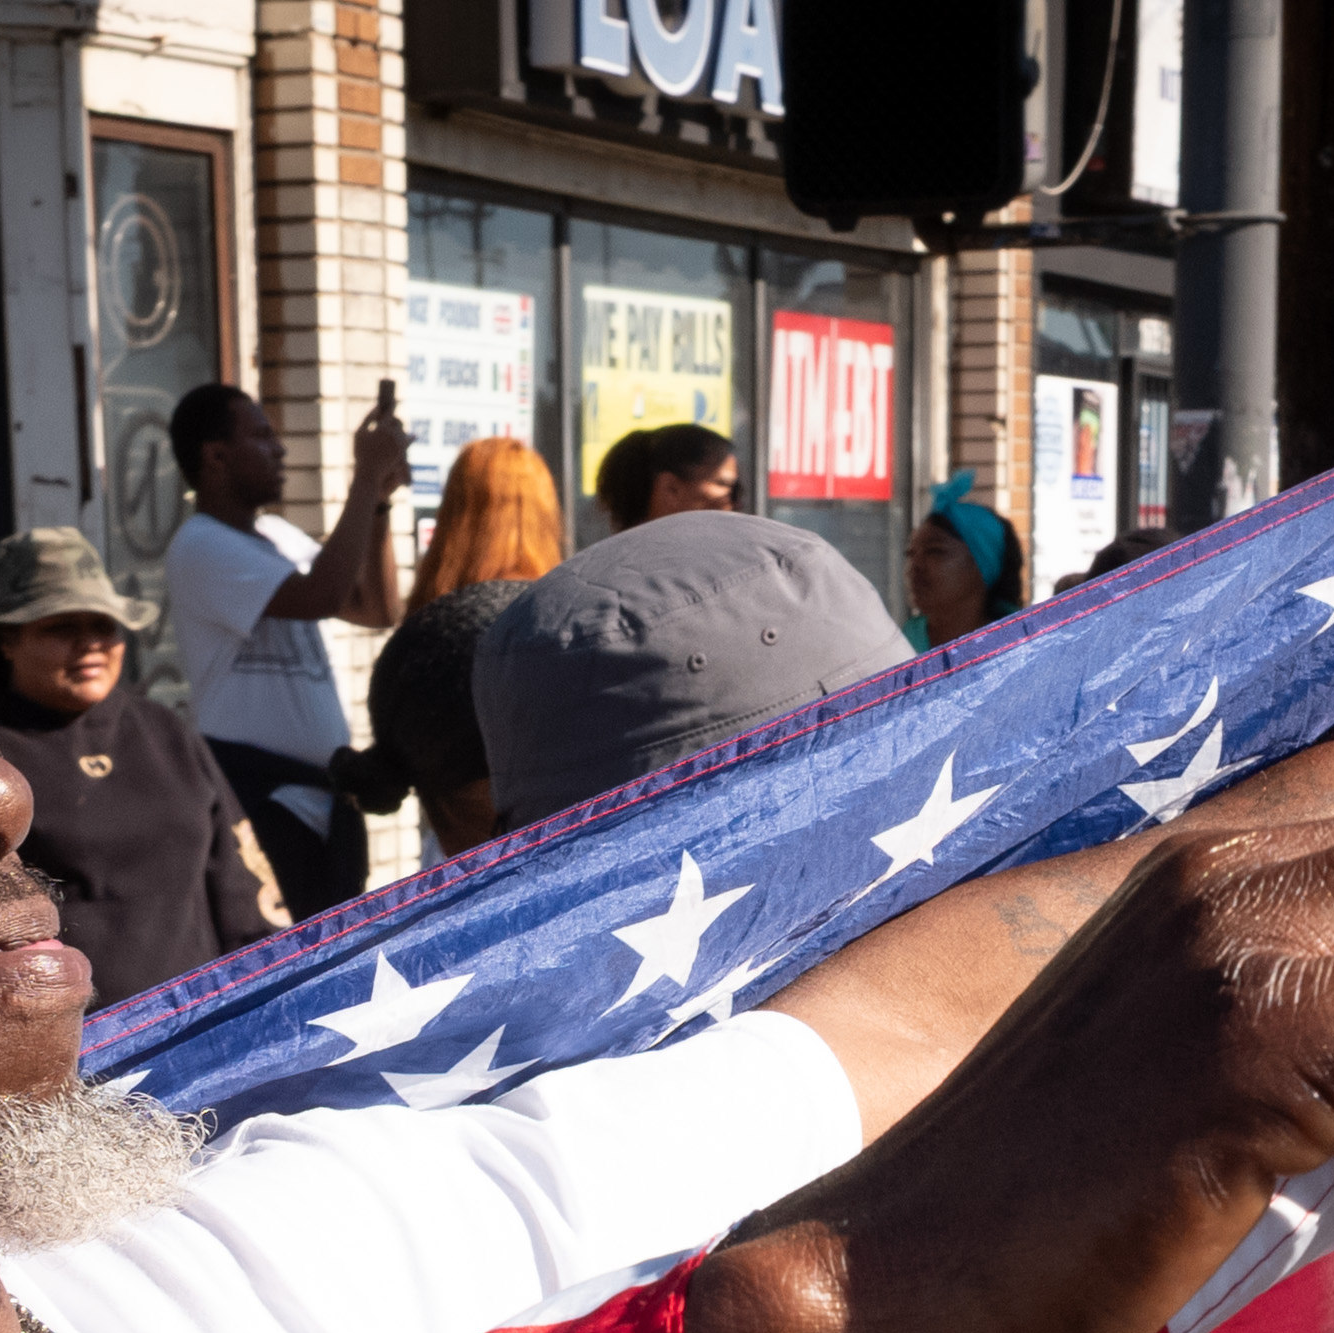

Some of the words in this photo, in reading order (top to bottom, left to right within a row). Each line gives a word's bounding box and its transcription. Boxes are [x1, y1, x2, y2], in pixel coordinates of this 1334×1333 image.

[584, 299, 616, 369] WE
[626, 303, 665, 373] PAY
[672, 309, 725, 377] BILLS
[768, 329, 829, 476] ATM
[835, 337, 894, 480] EBT
